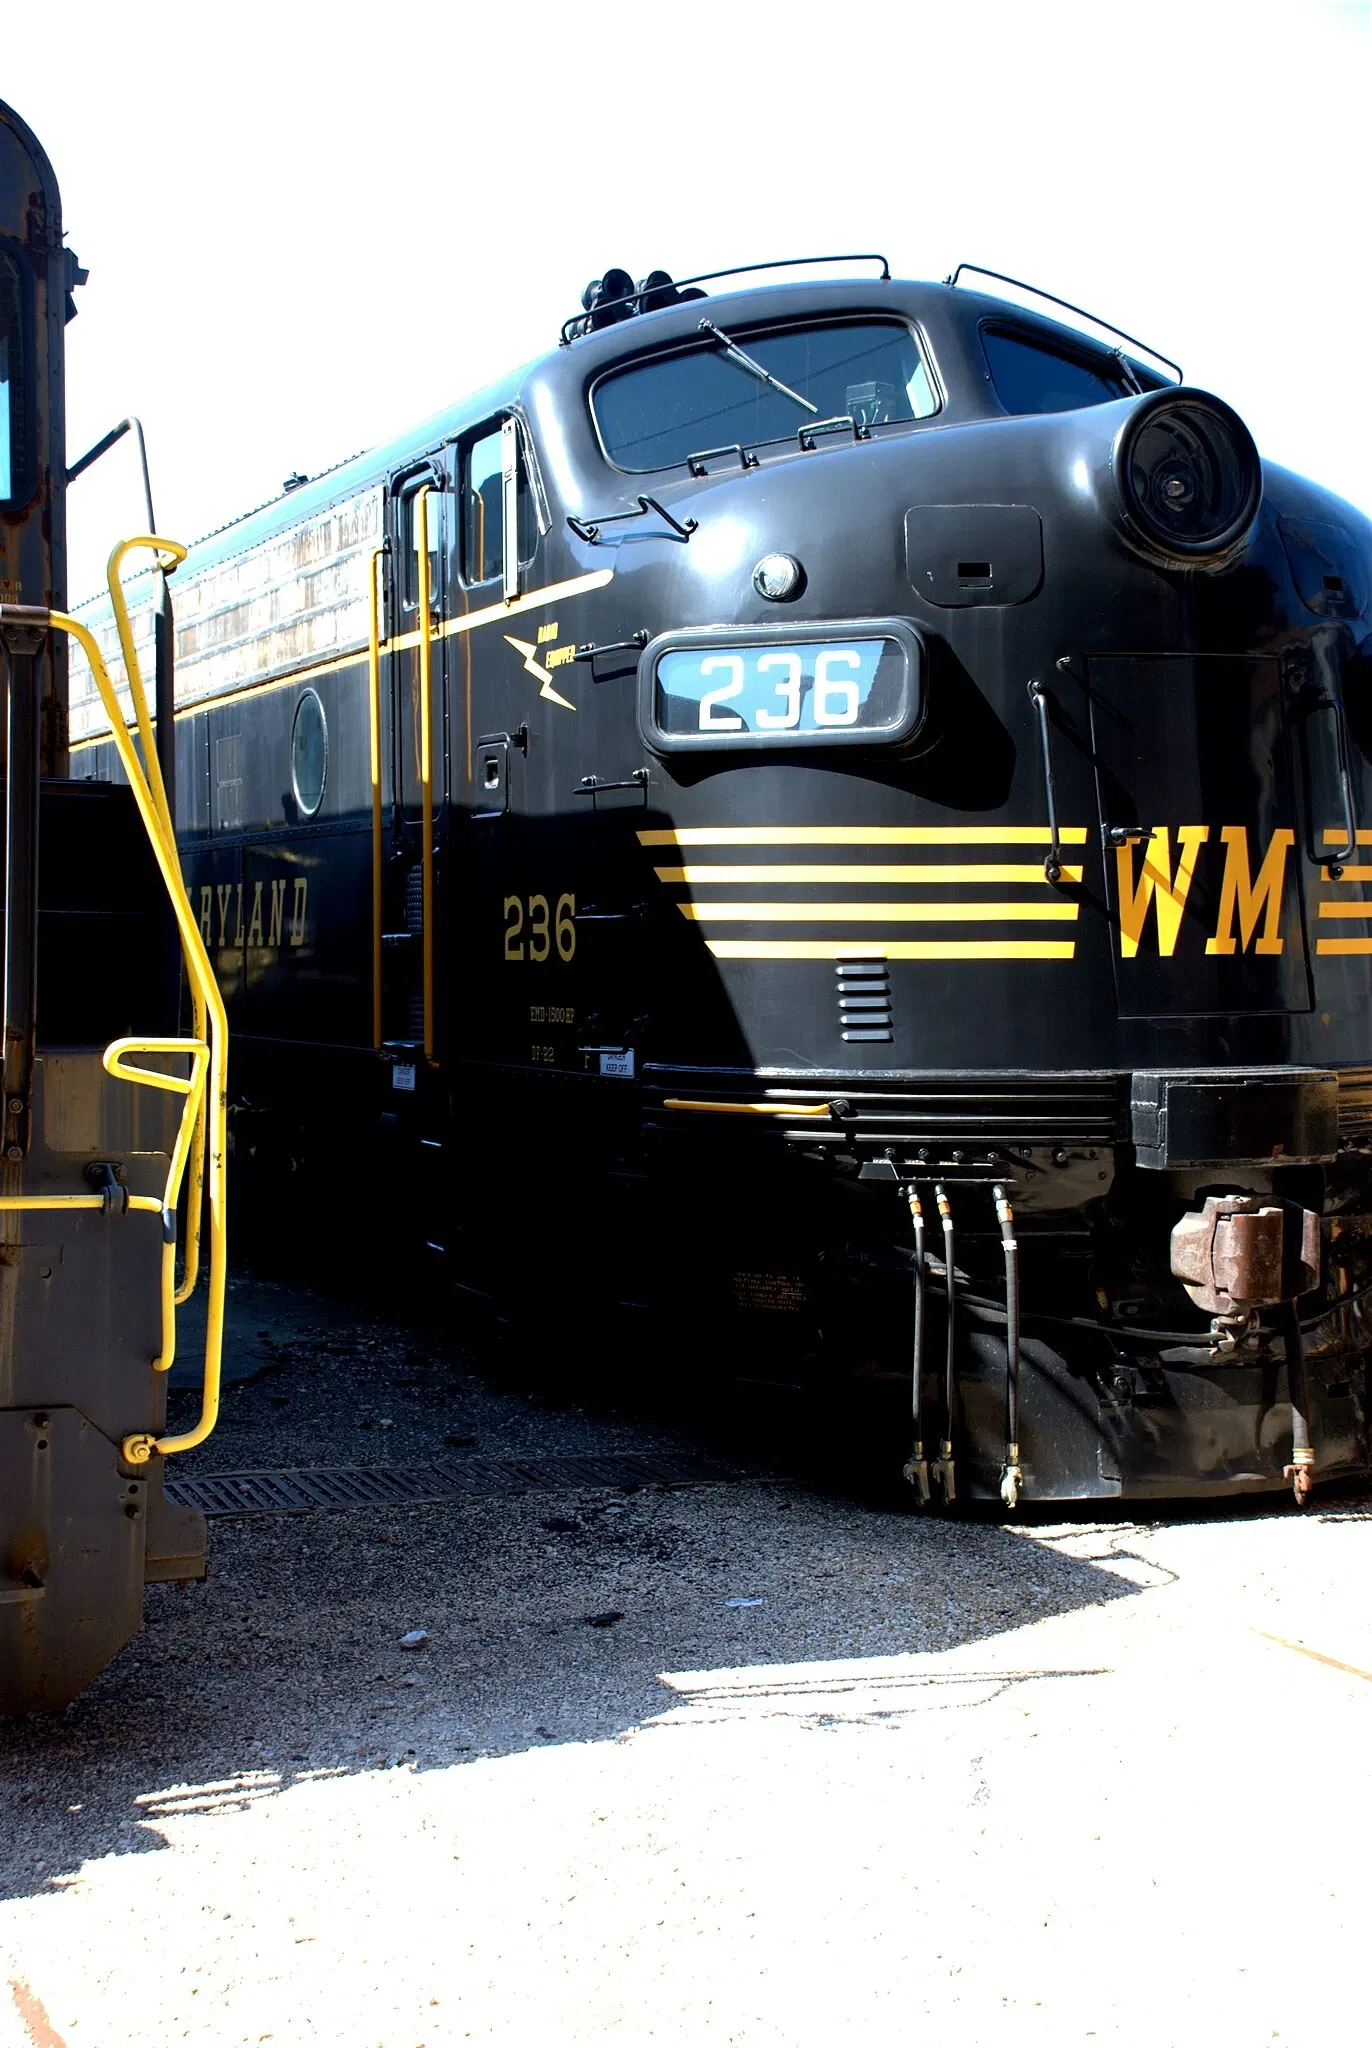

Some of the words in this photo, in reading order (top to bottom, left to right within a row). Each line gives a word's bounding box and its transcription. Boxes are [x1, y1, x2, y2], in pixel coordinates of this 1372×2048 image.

[698, 649, 861, 731] 236
[186, 877, 308, 947] RYLAND
[503, 892, 577, 963] 236
[1114, 826, 1296, 959] WM
[606, 1063, 618, 1072] KEEP
[618, 1064, 628, 1073] OFF
